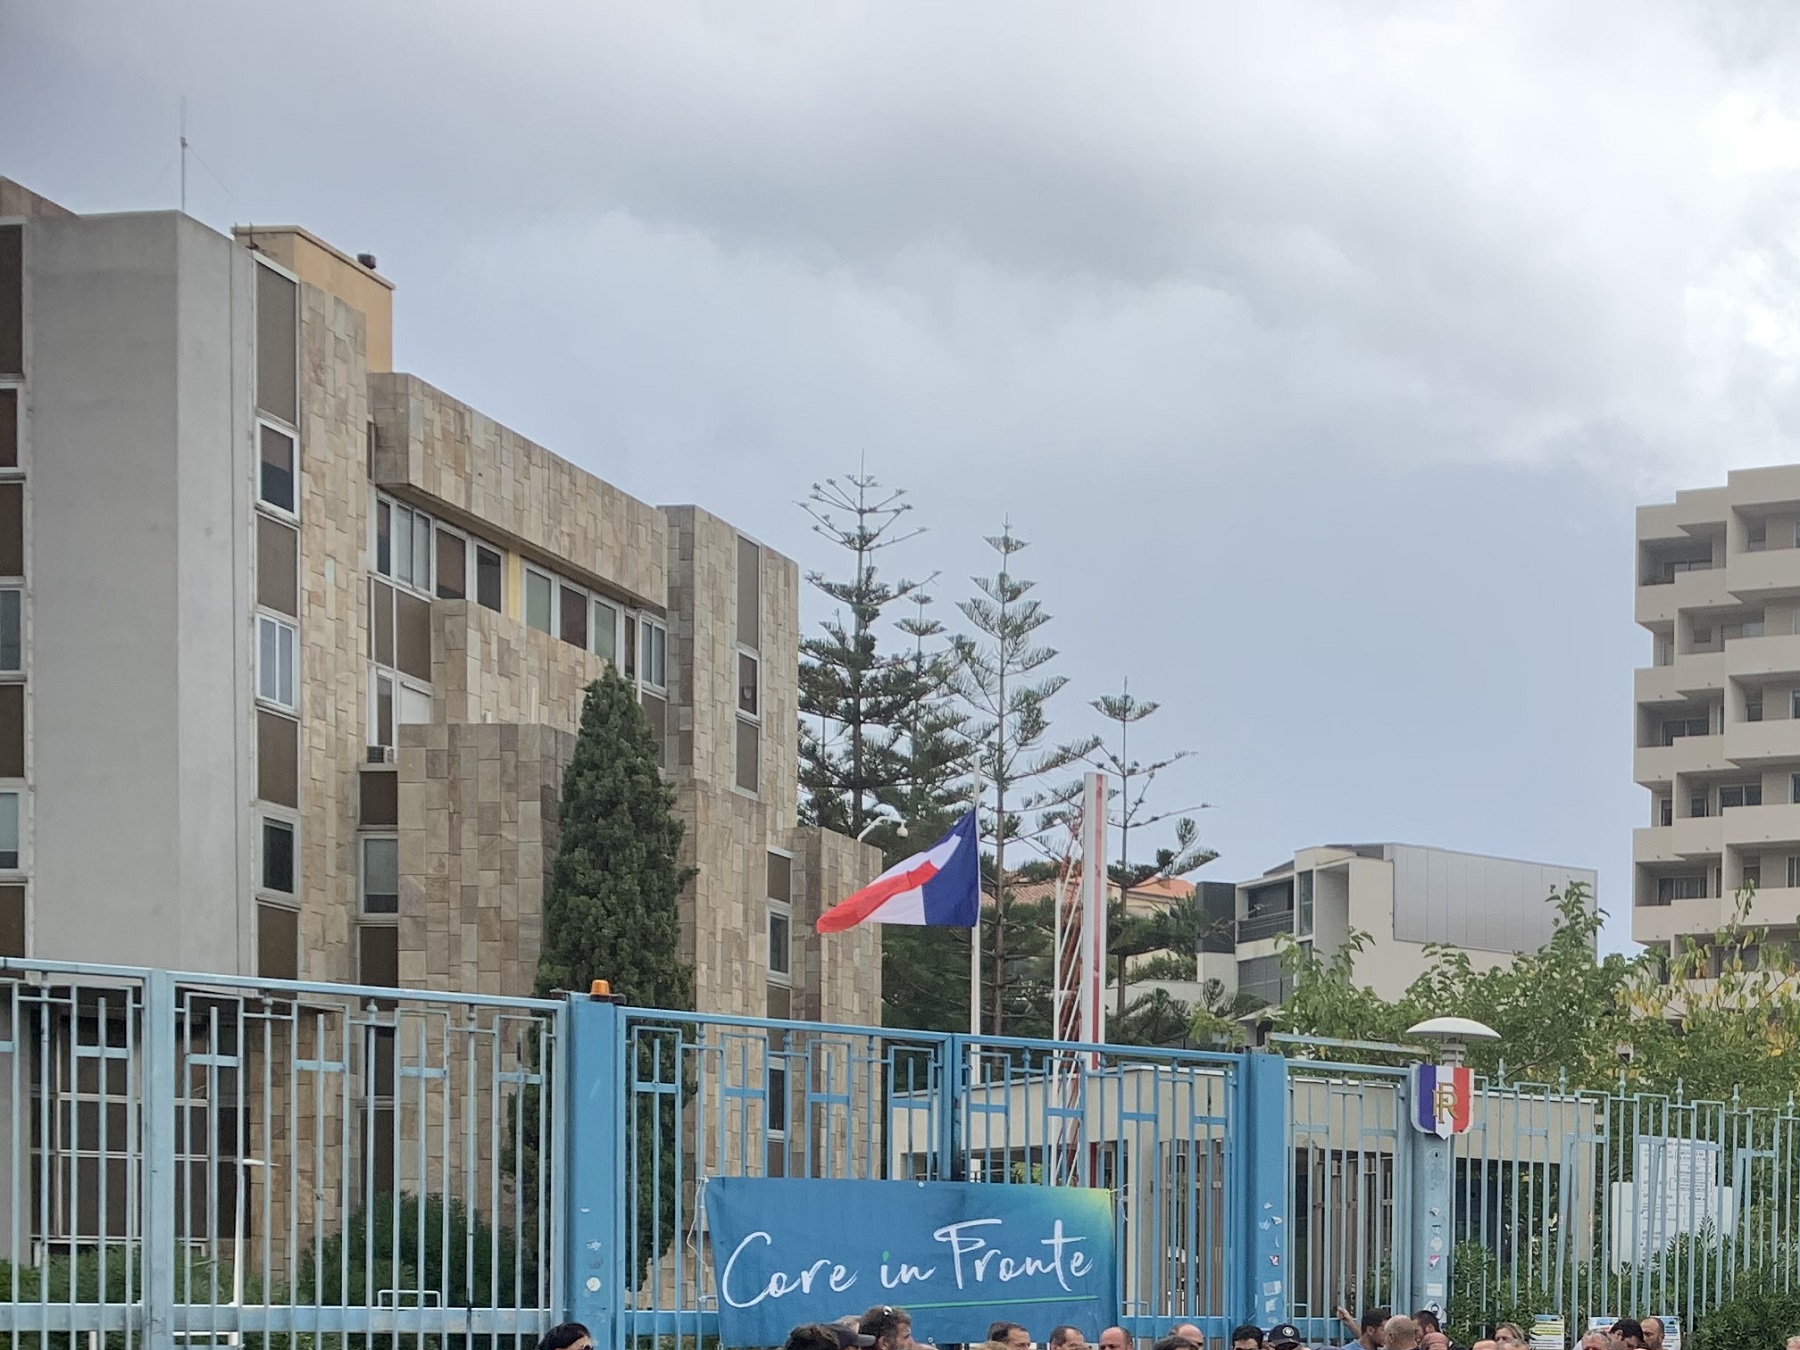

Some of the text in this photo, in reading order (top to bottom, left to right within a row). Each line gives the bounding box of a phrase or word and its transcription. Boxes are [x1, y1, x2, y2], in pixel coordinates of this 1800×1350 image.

[721, 1217, 1093, 1309] Core in Fronte
